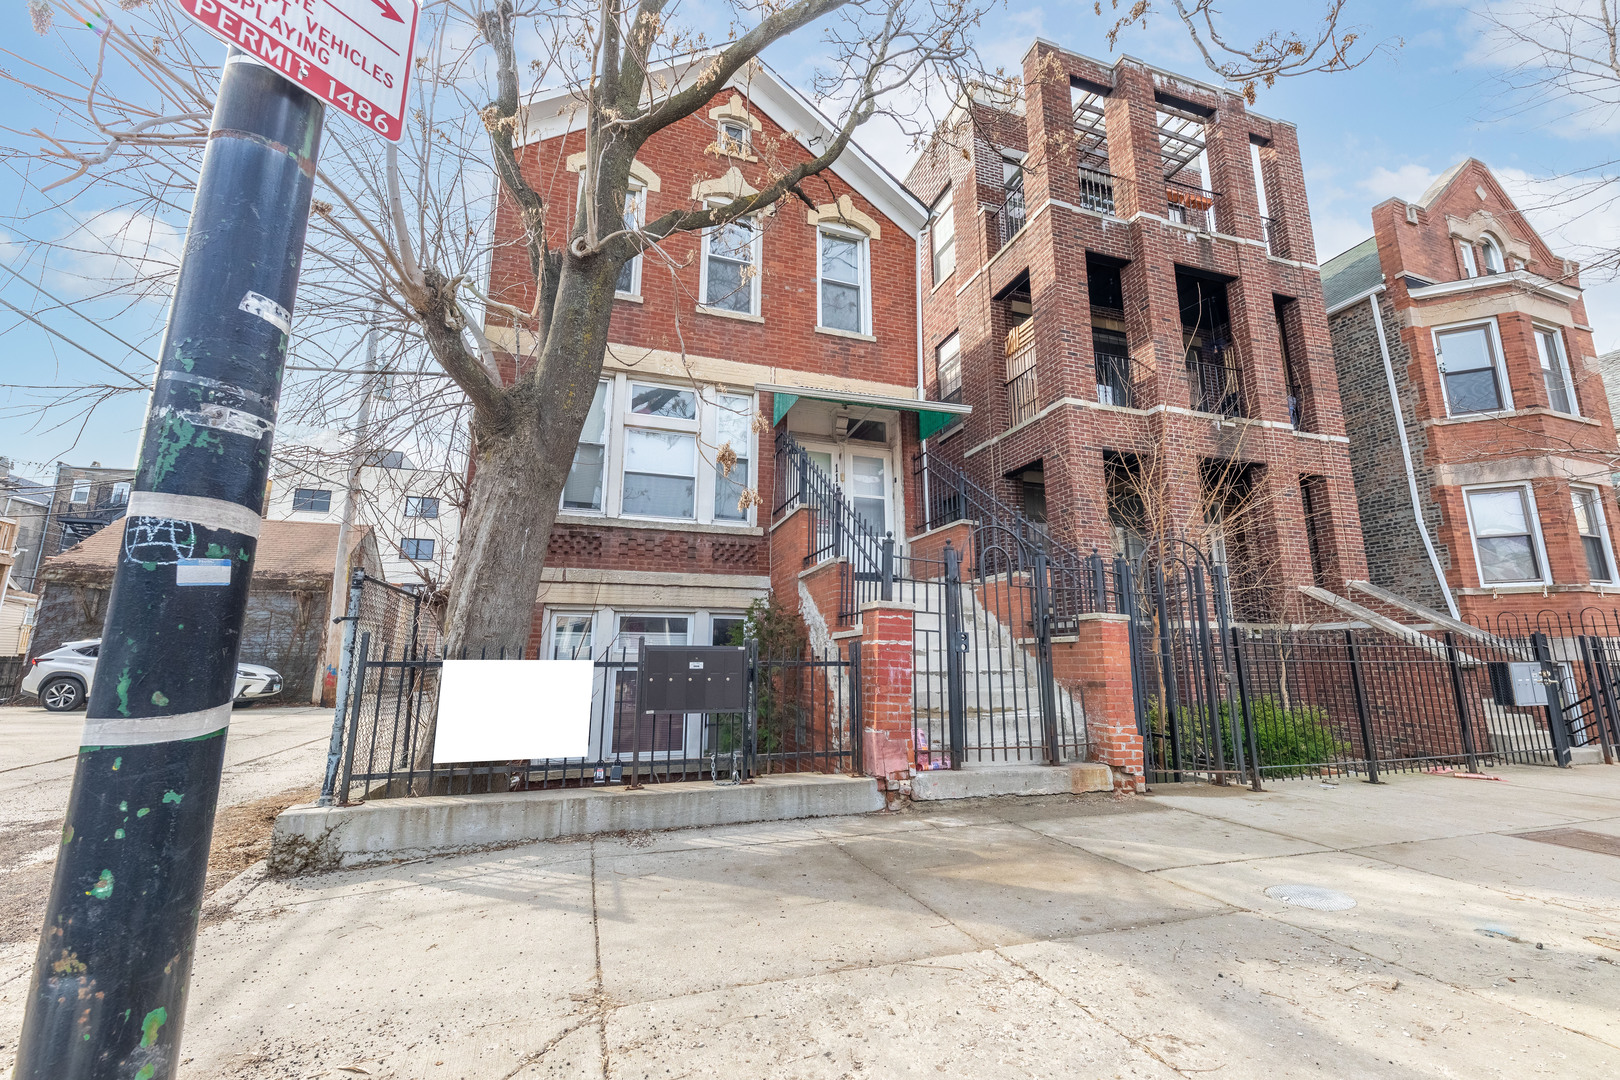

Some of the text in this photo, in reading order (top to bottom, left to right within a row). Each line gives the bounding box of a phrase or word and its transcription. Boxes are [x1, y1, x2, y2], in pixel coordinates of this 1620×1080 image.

[194, 0, 389, 133] PERMIT 1486
[306, 15, 394, 89] VEHICLES
